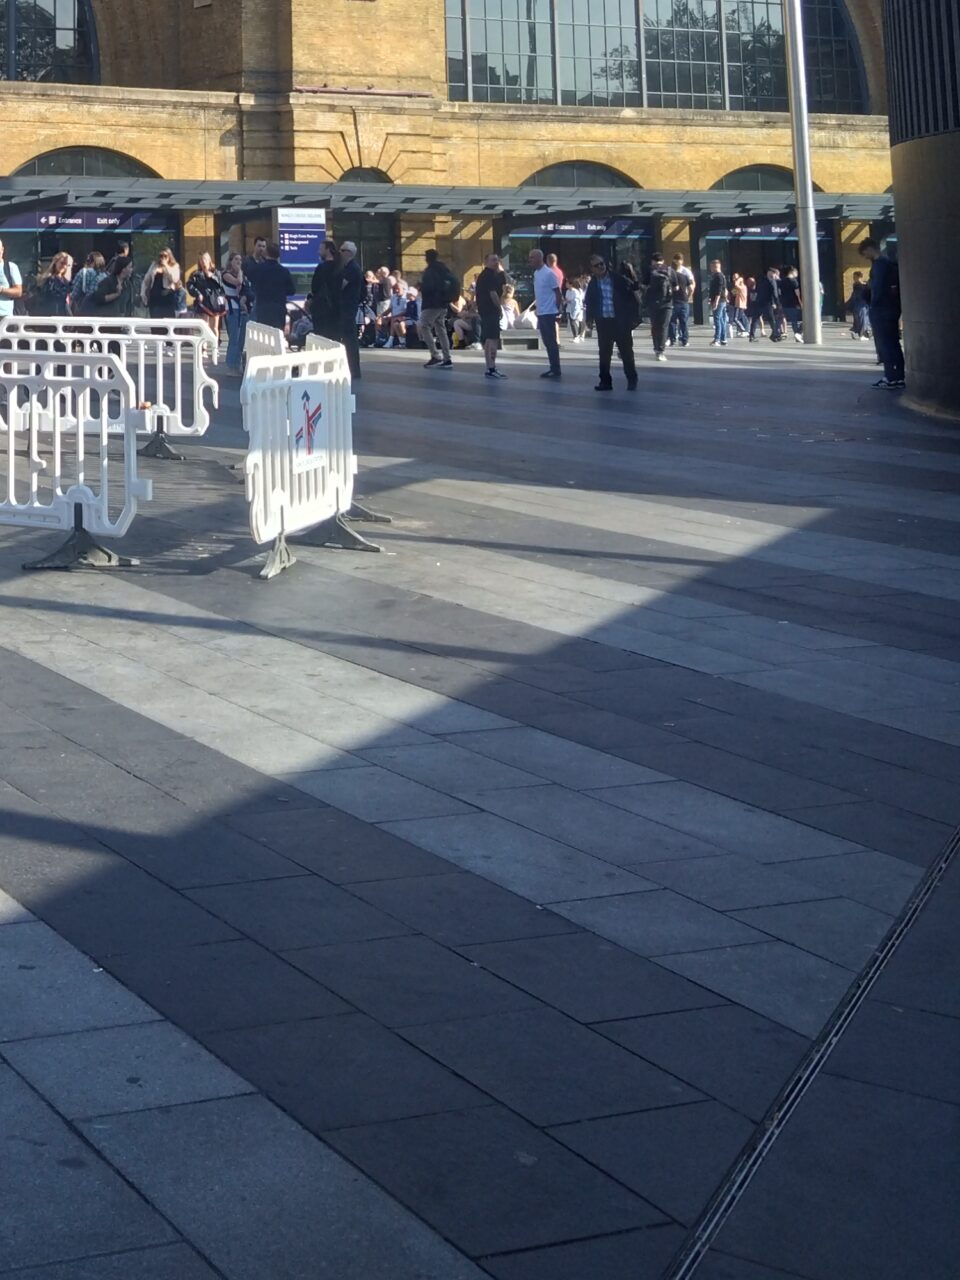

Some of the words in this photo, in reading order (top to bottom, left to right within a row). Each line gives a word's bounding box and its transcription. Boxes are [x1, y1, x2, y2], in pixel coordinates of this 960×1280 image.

[58, 216, 82, 224] Entrance
[96, 217, 108, 225] Exit
[108, 217, 121, 225] only
